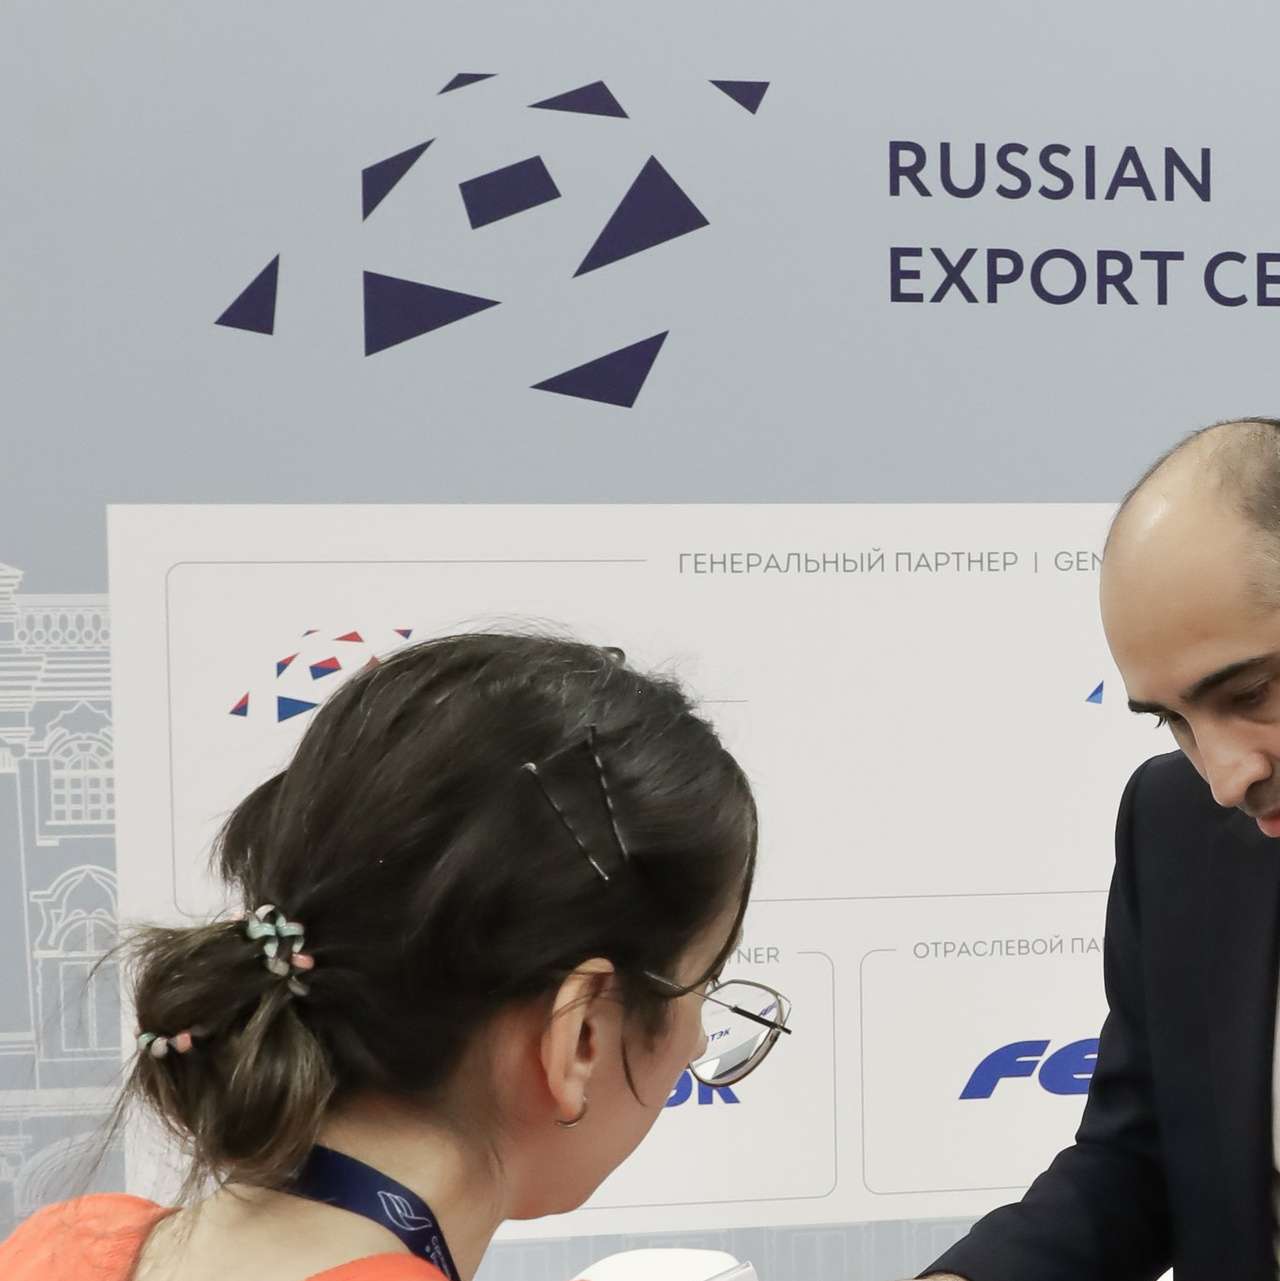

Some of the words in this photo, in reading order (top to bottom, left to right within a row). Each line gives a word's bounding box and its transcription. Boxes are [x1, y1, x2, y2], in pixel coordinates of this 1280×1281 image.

[889, 140, 1211, 203] RUSSIAN
[889, 246, 1185, 307] EXPORT
[679, 547, 886, 573] ГЕНЕРАЛЬНЫЙ
[895, 551, 1019, 572] ПАРТНЕР
[913, 934, 1064, 959] ОТРАСЛЕВОЙ
